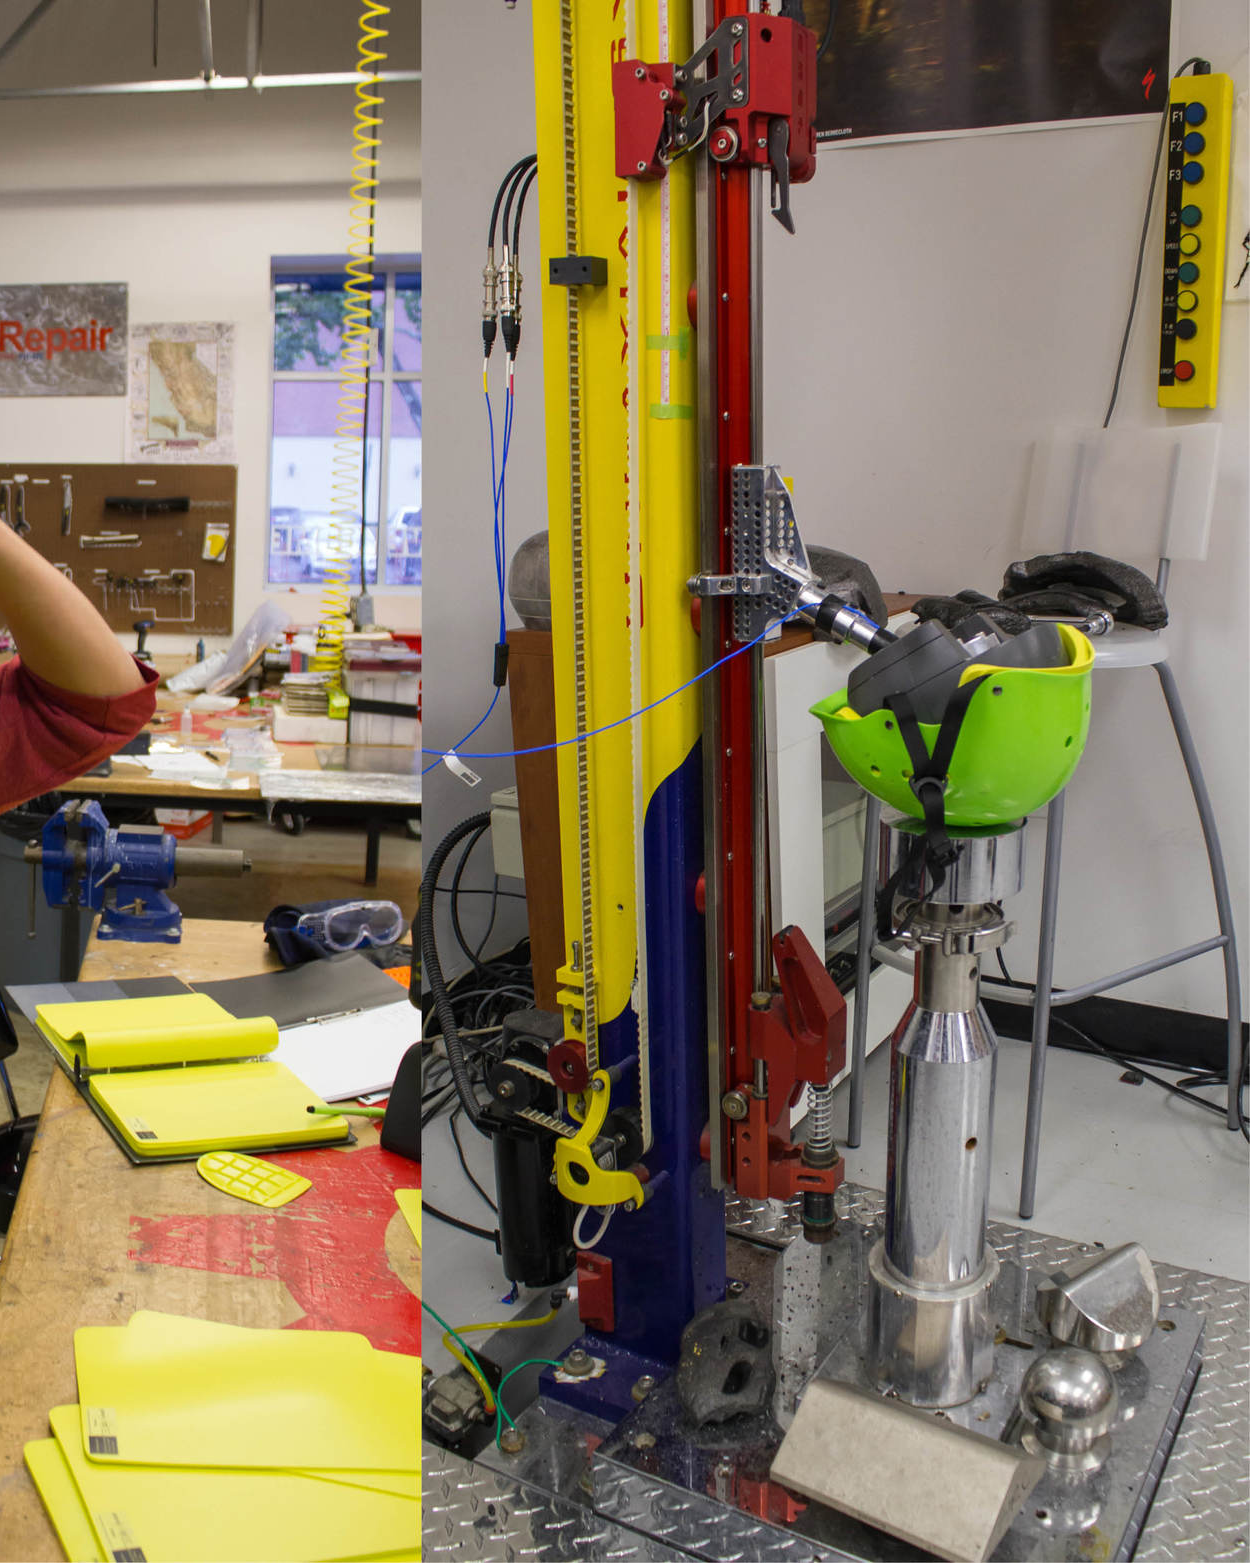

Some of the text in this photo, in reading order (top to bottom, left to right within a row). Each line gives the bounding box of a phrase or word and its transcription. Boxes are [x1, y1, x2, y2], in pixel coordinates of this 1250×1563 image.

[1171, 110, 1184, 122] F1
[1170, 140, 1183, 152] F2
[1169, 169, 1182, 181] F3
